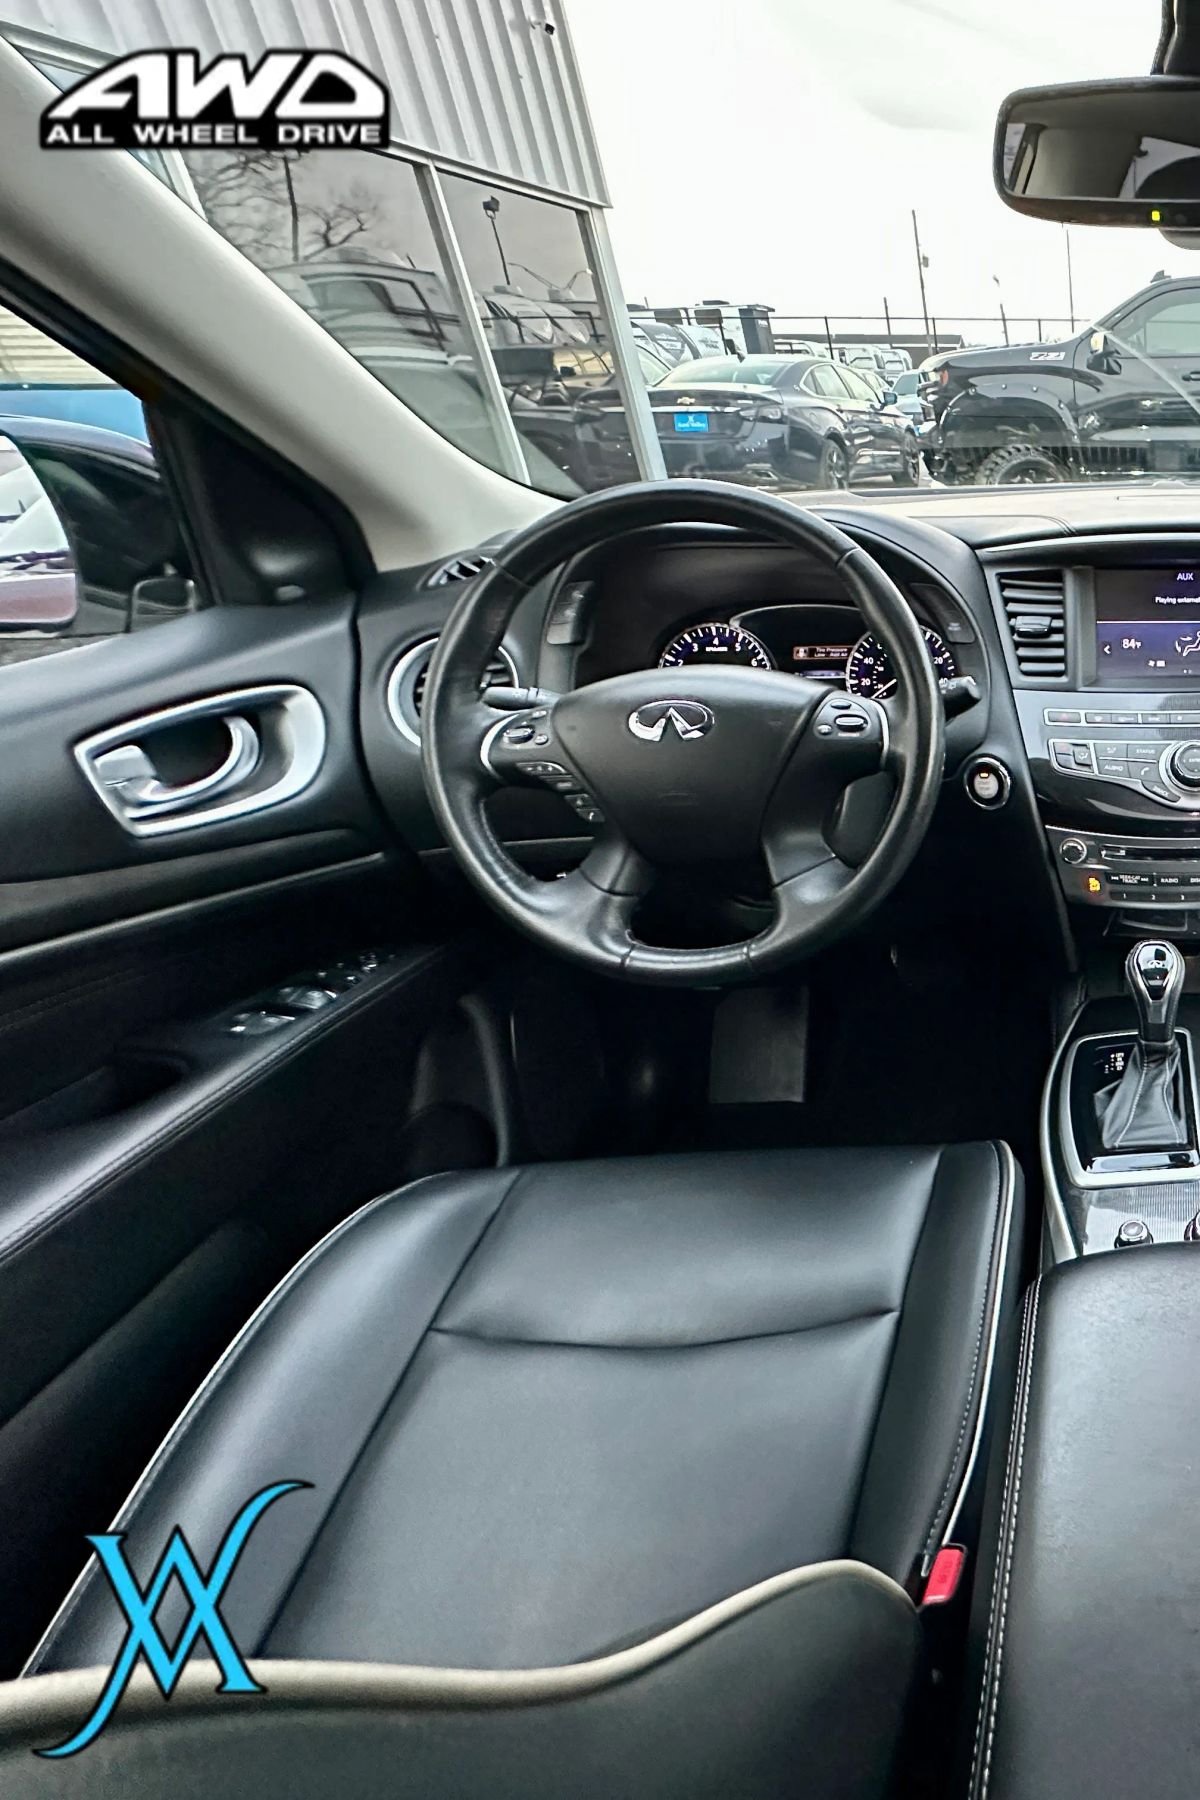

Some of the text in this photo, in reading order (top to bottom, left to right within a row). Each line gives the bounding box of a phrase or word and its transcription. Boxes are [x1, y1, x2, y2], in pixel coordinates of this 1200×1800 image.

[1177, 572, 1194, 581] AUX
[1155, 596, 1176, 604] Playing
[713, 637, 719, 645] 4
[692, 643, 699, 652] 3
[735, 642, 741, 651] 5
[751, 658, 758, 667] 6
[863, 657, 874, 665] 40
[934, 656, 944, 665] 20
[861, 678, 871, 686] 20
